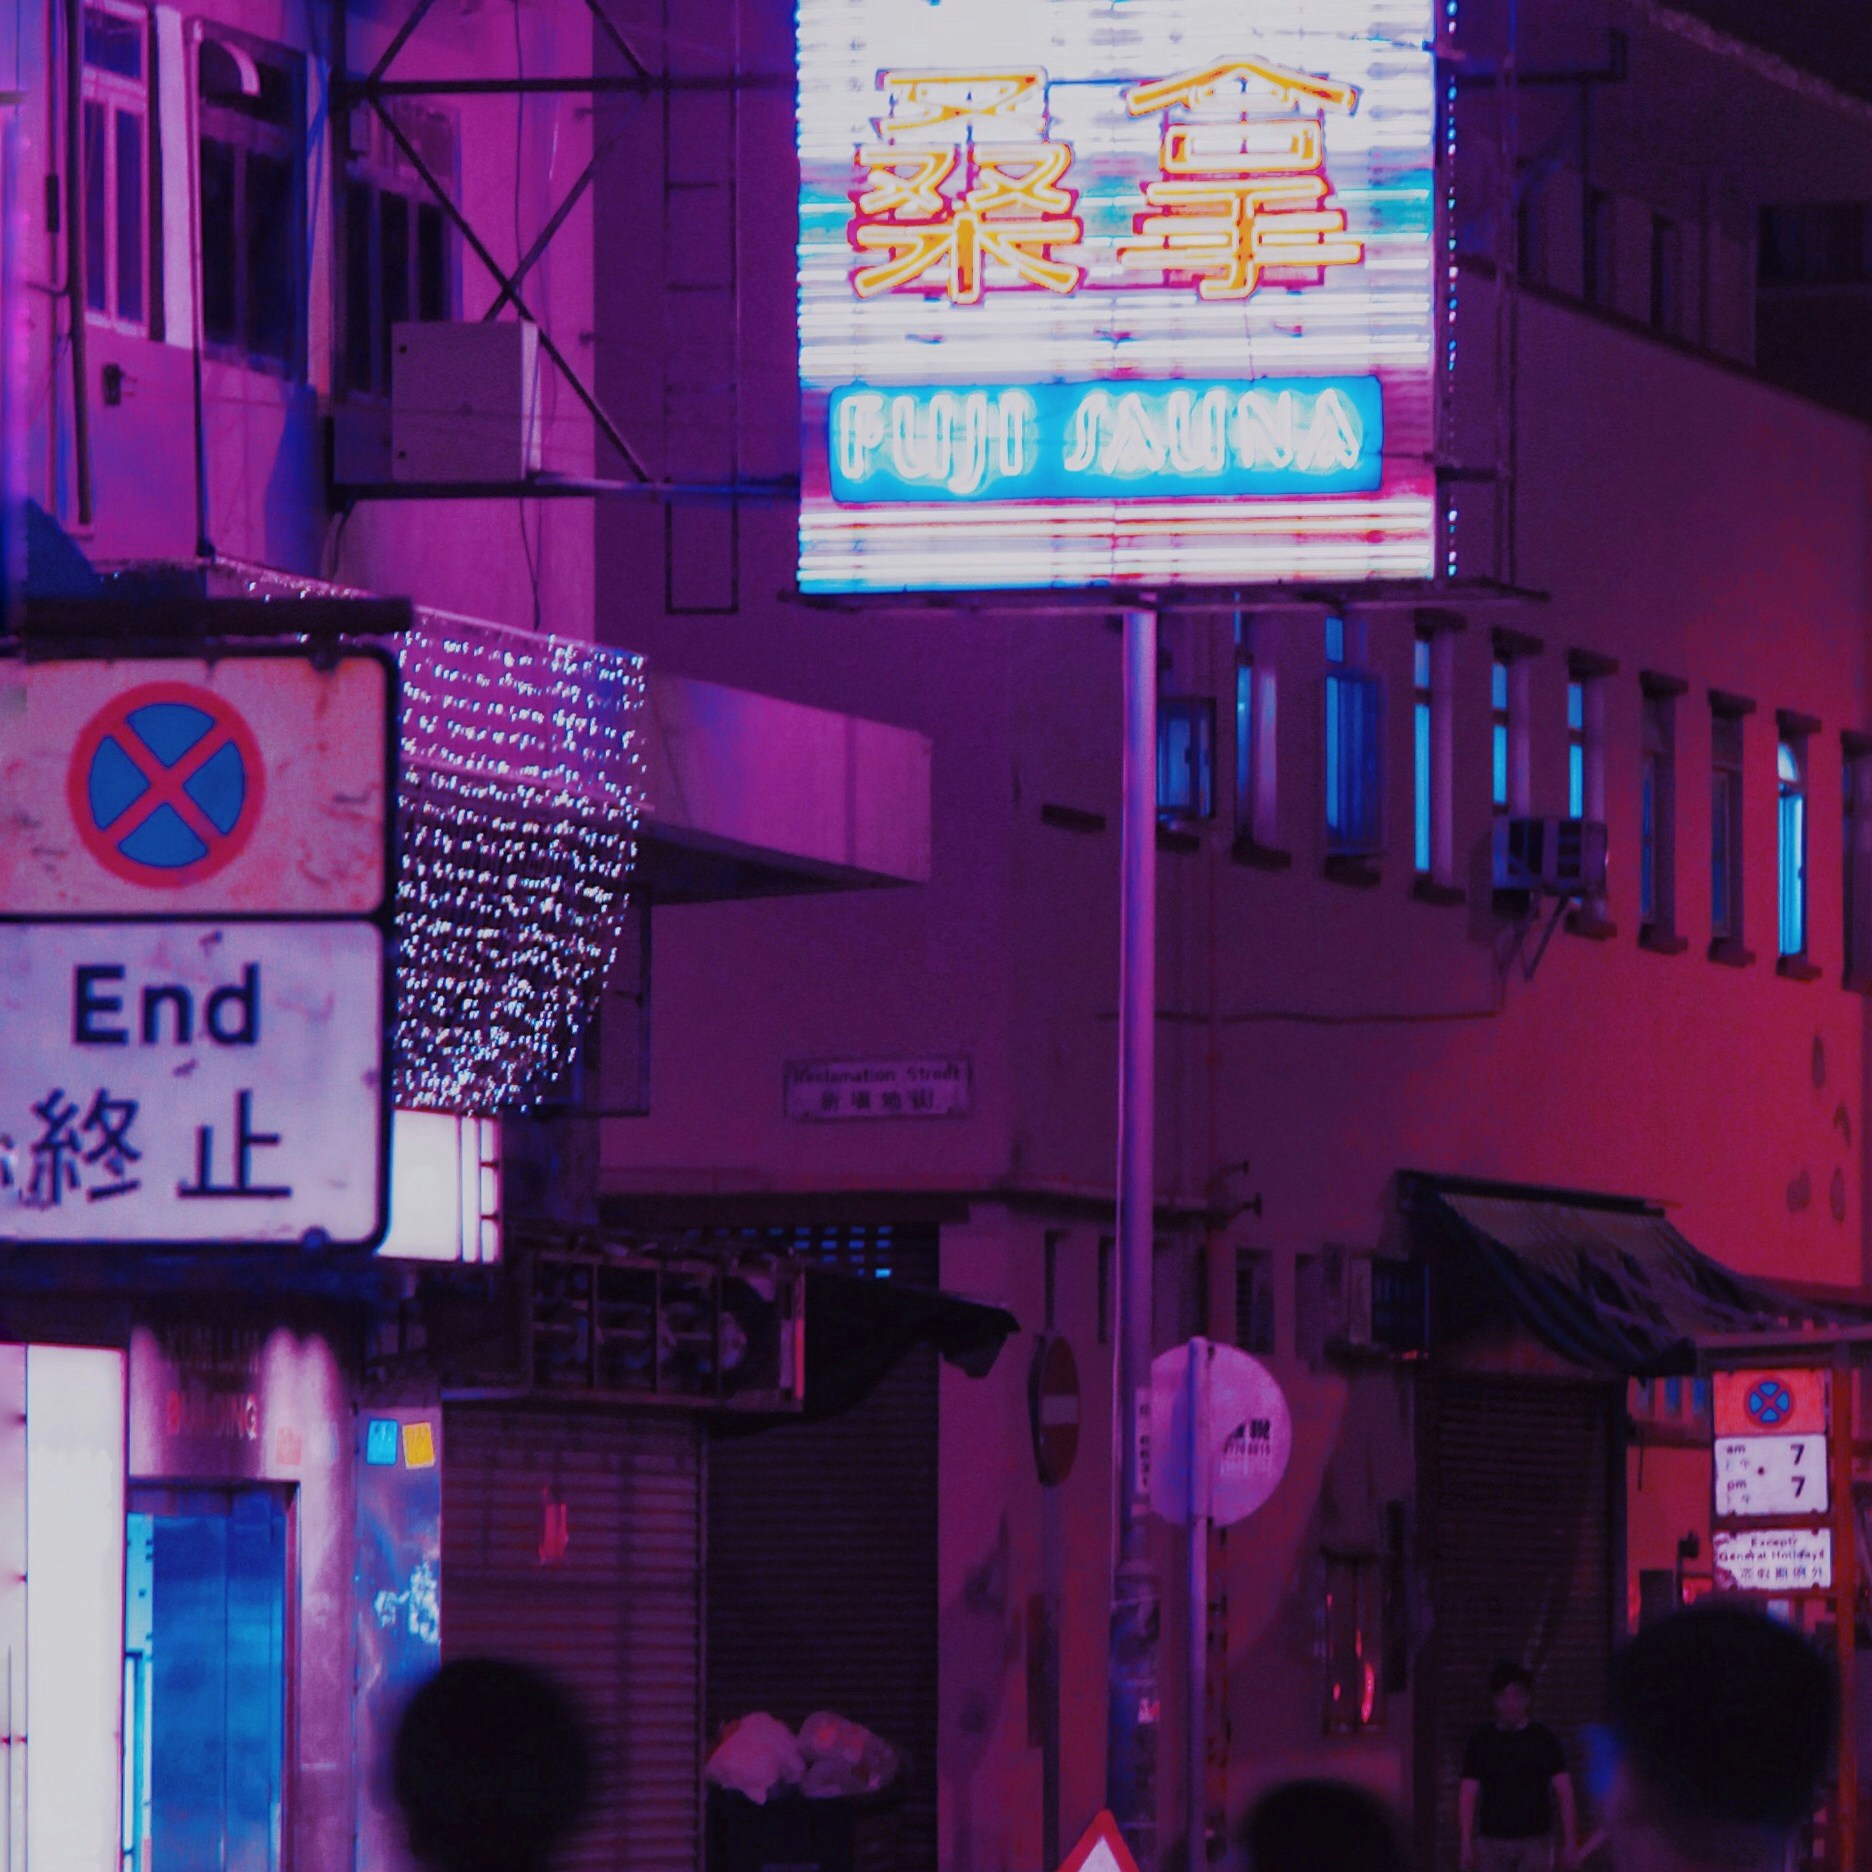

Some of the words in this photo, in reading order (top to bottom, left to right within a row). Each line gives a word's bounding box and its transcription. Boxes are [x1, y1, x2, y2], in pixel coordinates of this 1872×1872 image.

[848, 56, 1364, 305] 桑拿
[836, 387, 1033, 496] FUJI
[1063, 386, 1364, 475] SAUNA
[72, 960, 260, 1047] End
[30, 1087, 292, 1208] 終止
[1727, 1479, 1747, 1492] pm
[1791, 1475, 1806, 1499] 7
[1790, 1443, 1805, 1466] 7
